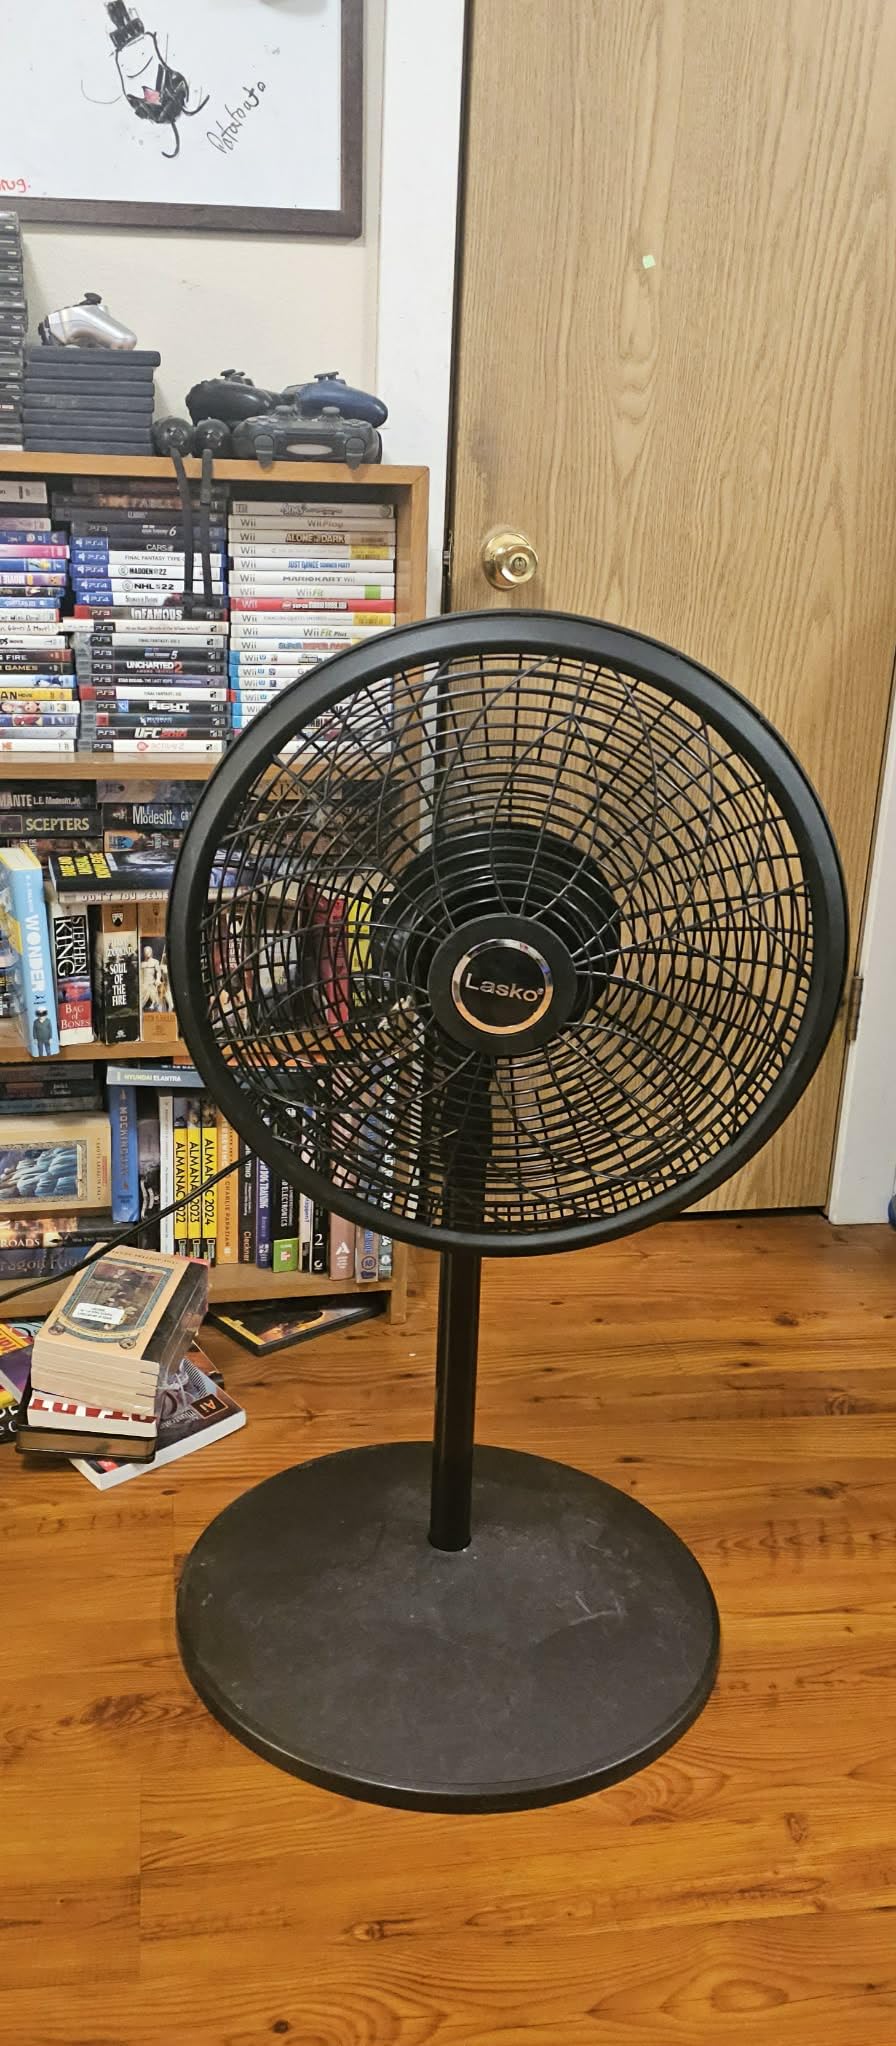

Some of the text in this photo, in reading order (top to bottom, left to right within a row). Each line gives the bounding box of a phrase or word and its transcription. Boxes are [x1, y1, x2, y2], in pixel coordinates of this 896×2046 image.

[240, 519, 256, 527] Wii
[169, 525, 177, 536] 6
[240, 533, 256, 541] Wii
[321, 534, 345, 543] DARK
[240, 546, 256, 555] Wii
[241, 560, 257, 569] Wii
[288, 560, 300, 569] JUST
[129, 567, 153, 575] MADDEN
[159, 568, 167, 576] 22
[240, 573, 256, 582] Wii
[240, 588, 256, 596] Wii
[242, 614, 257, 622] Wii
[242, 628, 258, 636] Wii
[241, 641, 257, 649] Wii
[171, 650, 179, 660] 5
[126, 661, 174, 669] UNCHARTED
[174, 661, 184, 673] 2
[134, 728, 161, 738] UFC
[25, 817, 90, 831] SCEPTERS
[55, 919, 76, 977] KING
[71, 916, 88, 974] STEPHEN
[25, 914, 45, 993] WONDER
[109, 962, 128, 975] SOUL
[114, 974, 124, 985] OF
[112, 984, 127, 996] THE
[112, 995, 127, 1007] FIRE
[189, 1141, 200, 1195] ALMANA
[175, 1141, 186, 1224] ALMANAC 022
[204, 1138, 215, 1226] ALMANC 2024
[280, 1187, 289, 1228] ELECTRONICS
[314, 1233, 324, 1246] 2
[243, 1231, 251, 1262] Cleckner
[200, 1399, 217, 1413] Ai
